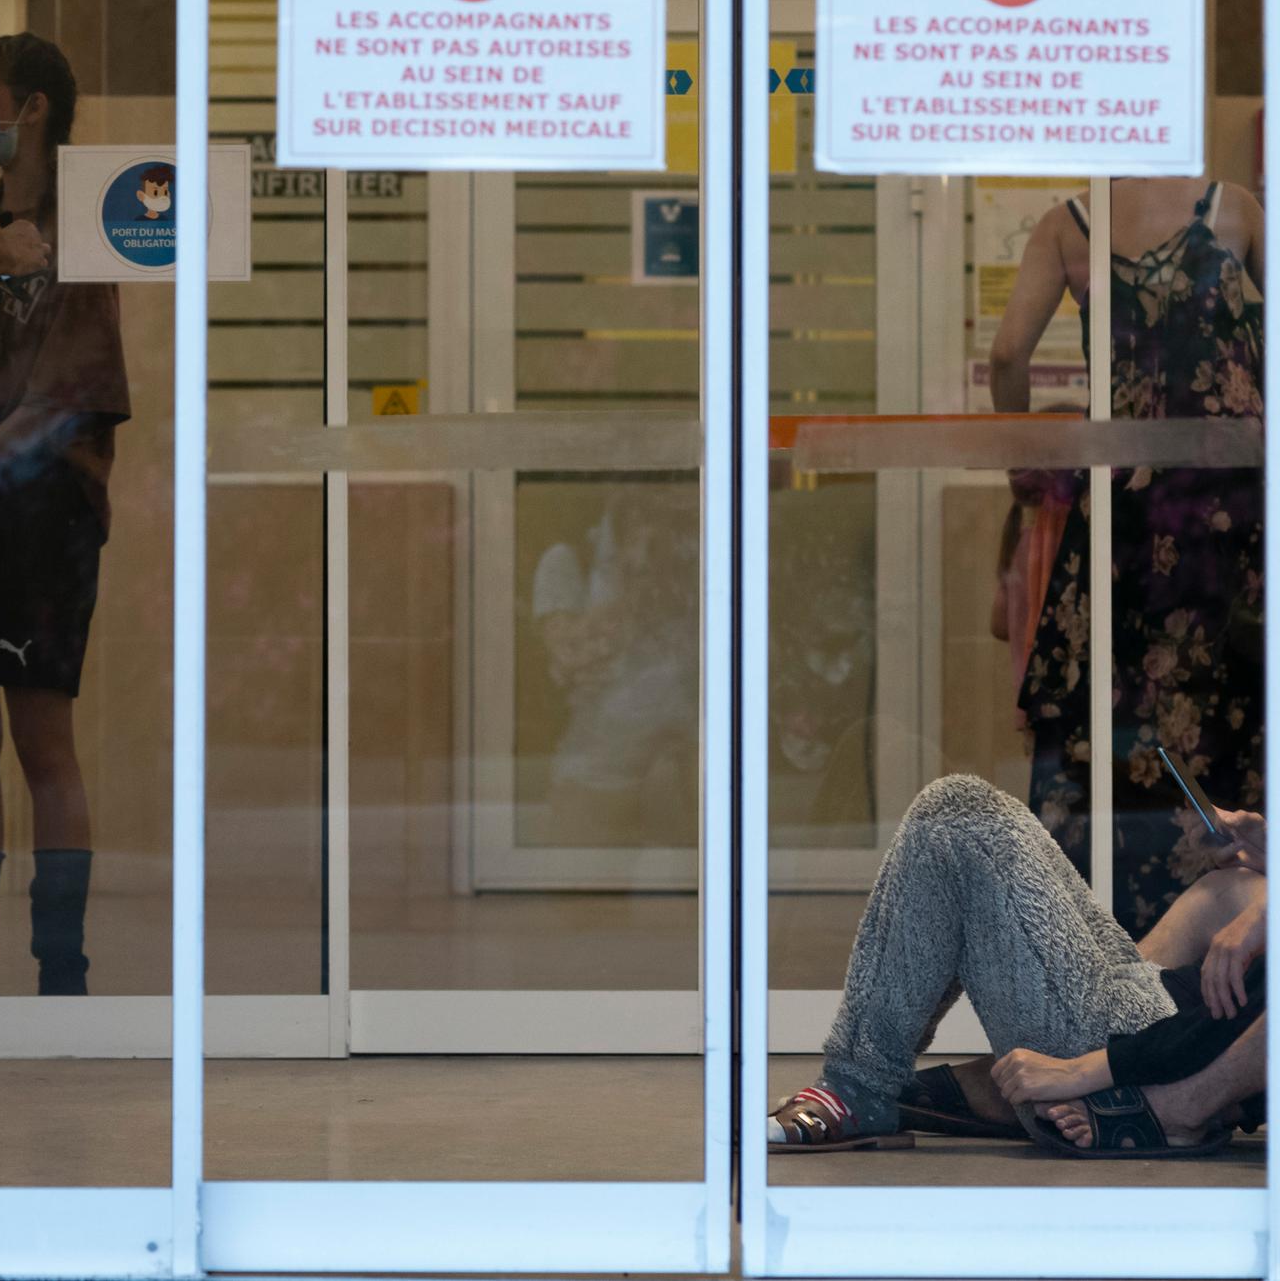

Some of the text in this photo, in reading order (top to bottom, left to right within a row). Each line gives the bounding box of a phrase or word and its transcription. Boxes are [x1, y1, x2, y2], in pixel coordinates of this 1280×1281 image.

[336, 12, 611, 31] LES ACCOMPAGNANTS
[875, 17, 1149, 35] LES ACCOMPAGNANTS
[316, 39, 631, 58] NE SONT PAS AUTORISES
[854, 44, 1170, 63] NE SONT PAS AUTORISES
[402, 66, 542, 83] AU SEIN DE
[940, 72, 1082, 89] AU SEIN DE
[324, 92, 622, 111] L'ETABLISSEMENT SAUF
[862, 98, 1160, 117] L'ETABLISSEMENT SAUF
[314, 119, 631, 138] SUR DECISION MEDICALE
[852, 125, 1170, 143] SUR DECISION MEDICALE
[112, 228, 138, 237] PORT
[140, 228, 154, 236] DU
[123, 239, 176, 248] OBLIGATOI
